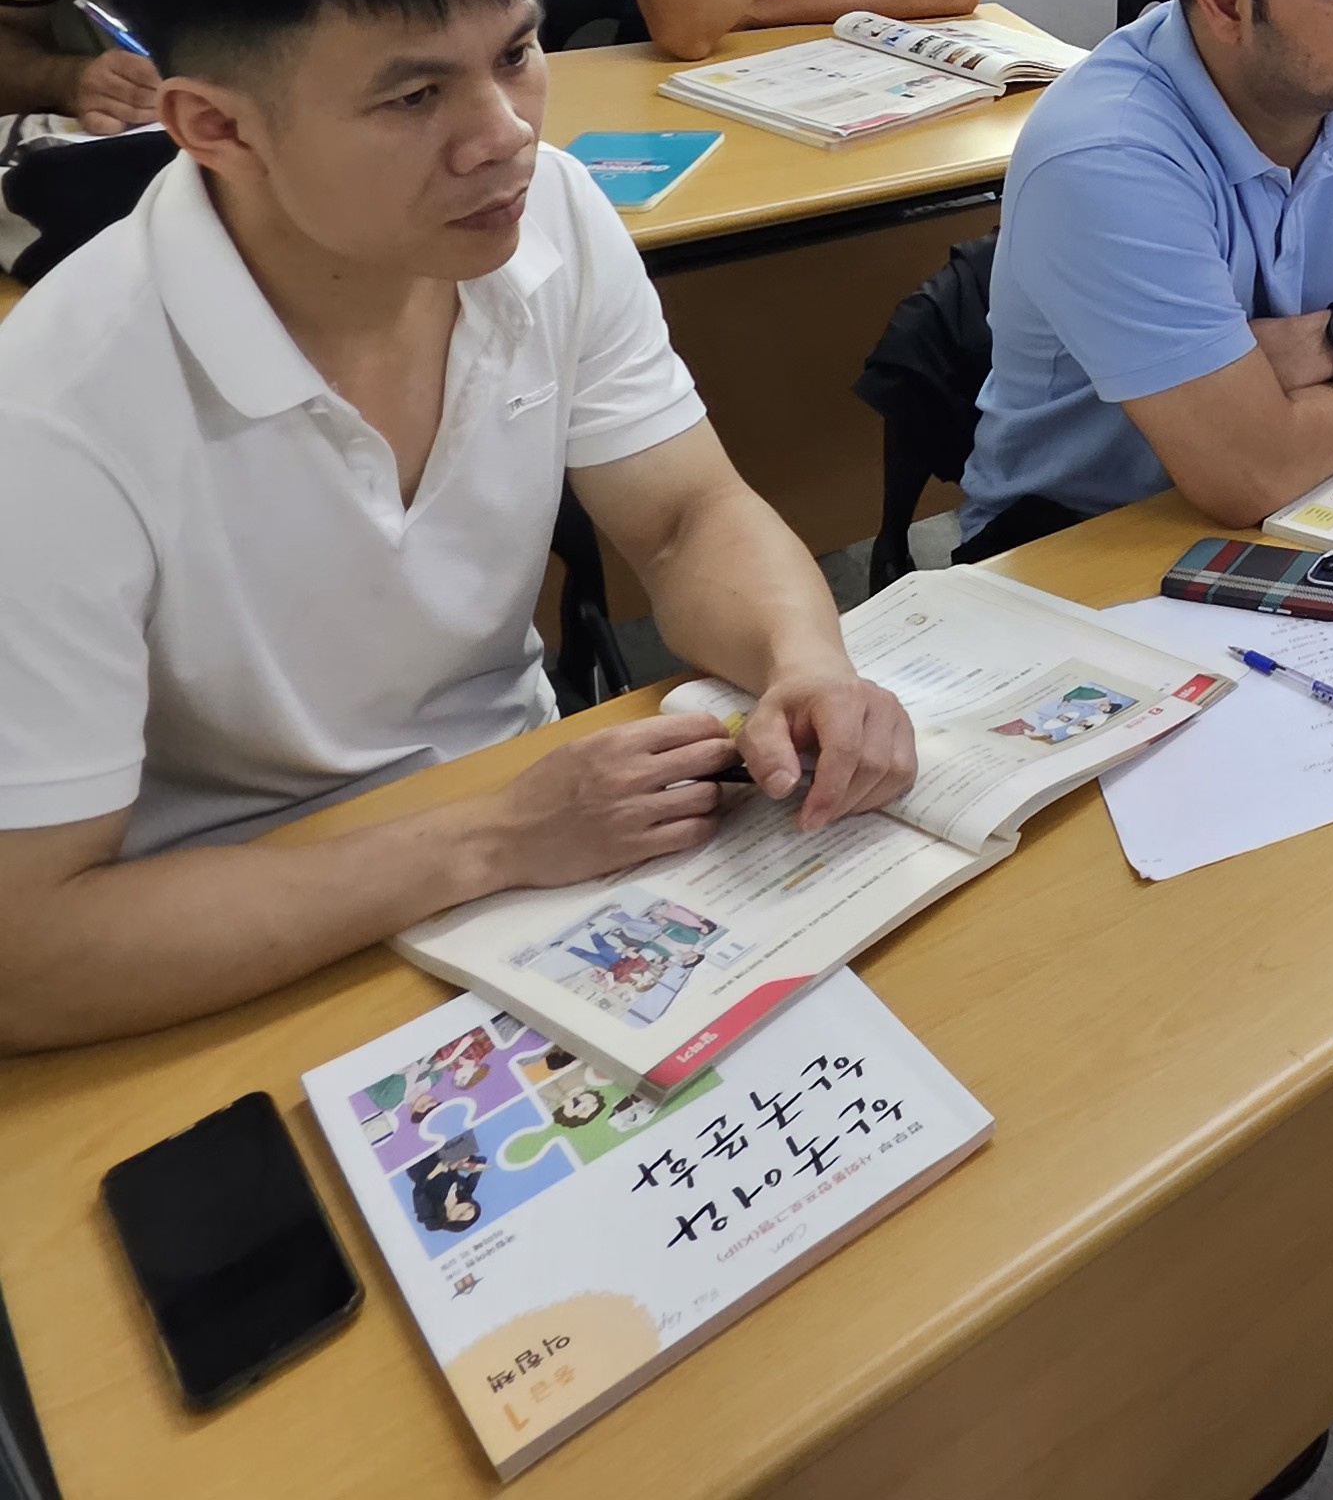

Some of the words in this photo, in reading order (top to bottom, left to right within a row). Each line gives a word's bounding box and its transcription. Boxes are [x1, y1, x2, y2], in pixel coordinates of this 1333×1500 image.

[631, 1055, 867, 1190] 한국문화
[877, 1121, 924, 1154] 법무부
[666, 1097, 905, 1249] 한국어와
[715, 1155, 873, 1264] 사회통합프로그램(KIIP)
[486, 1334, 572, 1394] 익힘책
[529, 1364, 577, 1404] 중급
[503, 1403, 530, 1433] 1
